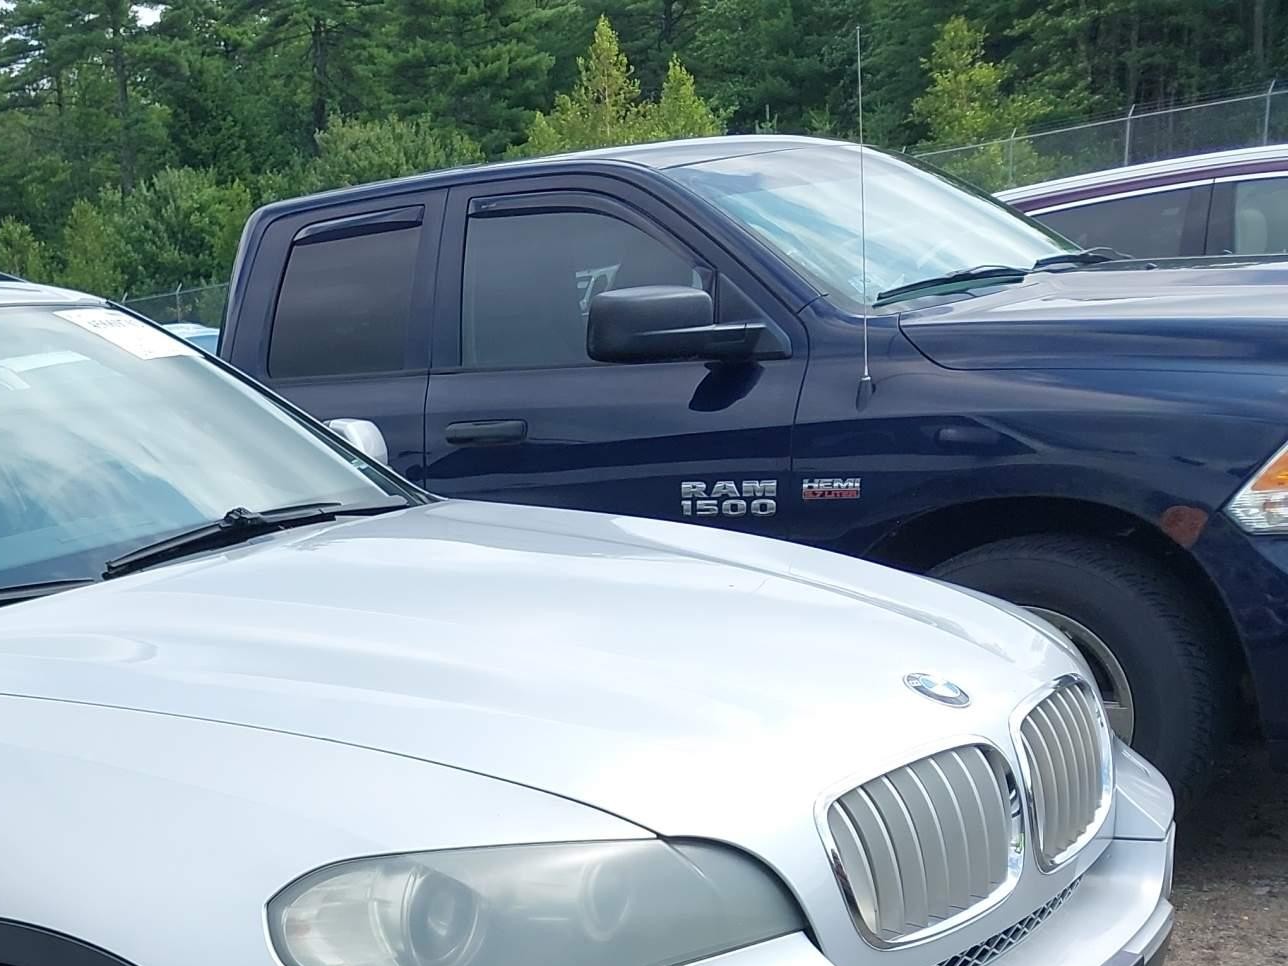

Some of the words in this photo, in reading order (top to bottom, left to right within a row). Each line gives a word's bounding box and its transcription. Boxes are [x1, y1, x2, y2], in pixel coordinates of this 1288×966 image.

[680, 479, 778, 498] RAM
[802, 478, 861, 489] HEMI
[680, 498, 777, 517] 1500
